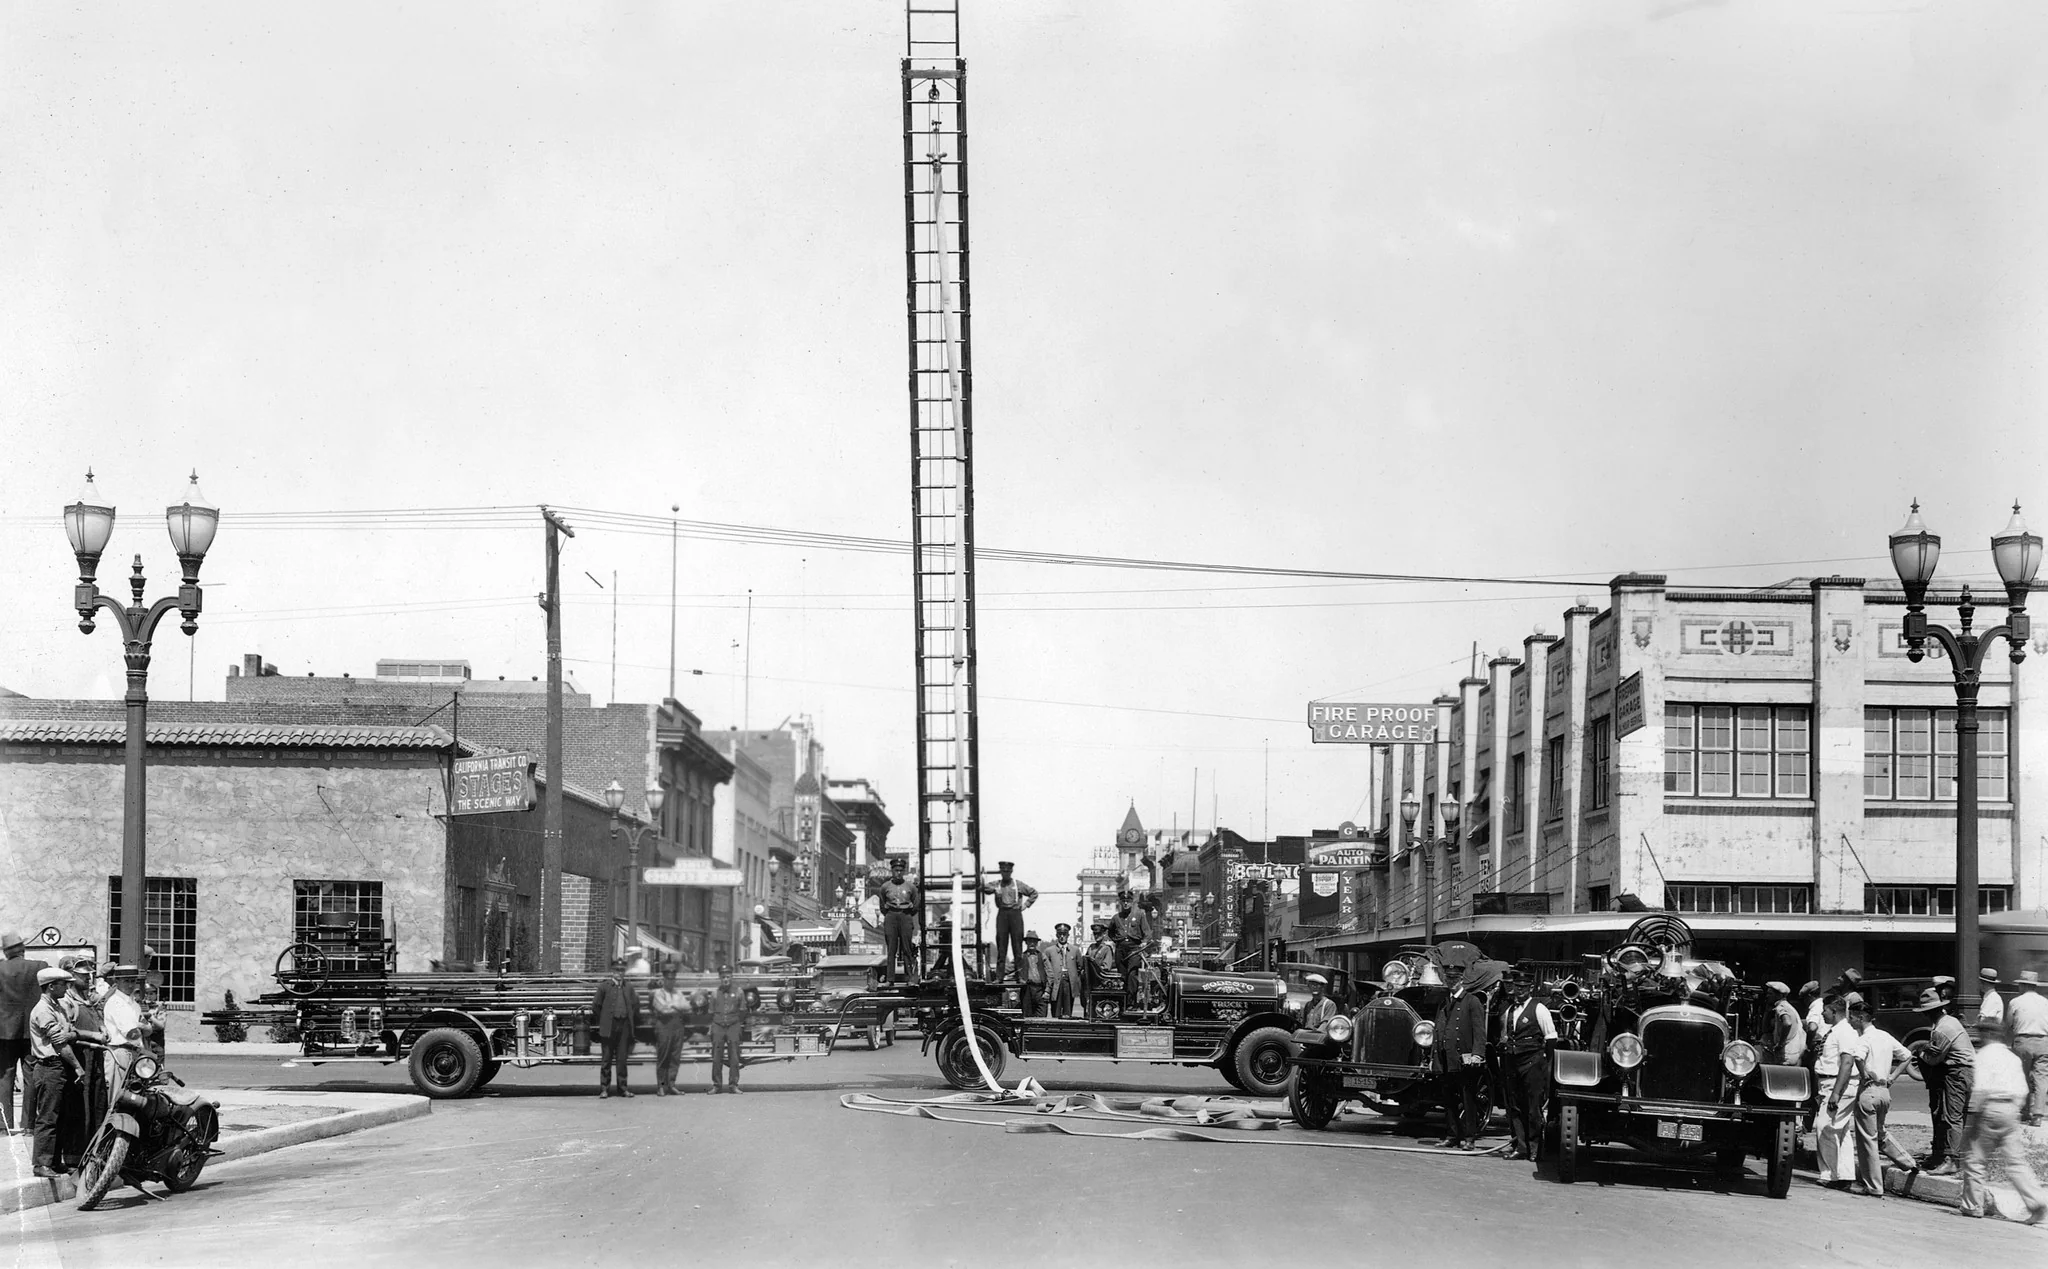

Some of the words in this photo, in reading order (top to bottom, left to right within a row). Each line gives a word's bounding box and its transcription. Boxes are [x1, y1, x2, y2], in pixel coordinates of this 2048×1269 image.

[1312, 706, 1357, 721] FIRE
[1366, 707, 1436, 722] PROOF
[1618, 695, 1640, 720] GARAGE
[1329, 724, 1420, 740] GARAGE
[454, 760, 489, 774] CALIFORNIA
[490, 756, 516, 771] TRANSIT
[459, 770, 522, 798] STAGES
[457, 799, 471, 810] THE
[474, 796, 502, 809] SCENIC
[505, 795, 521, 806] WAY
[794, 795, 820, 804] LYRIC
[800, 805, 812, 892] THEATRE
[1225, 858, 1234, 892] CHOP
[1225, 895, 1234, 928] SUEY
[1201, 980, 1255, 992] MODESTO
[1211, 1001, 1241, 1009] TRUCK
